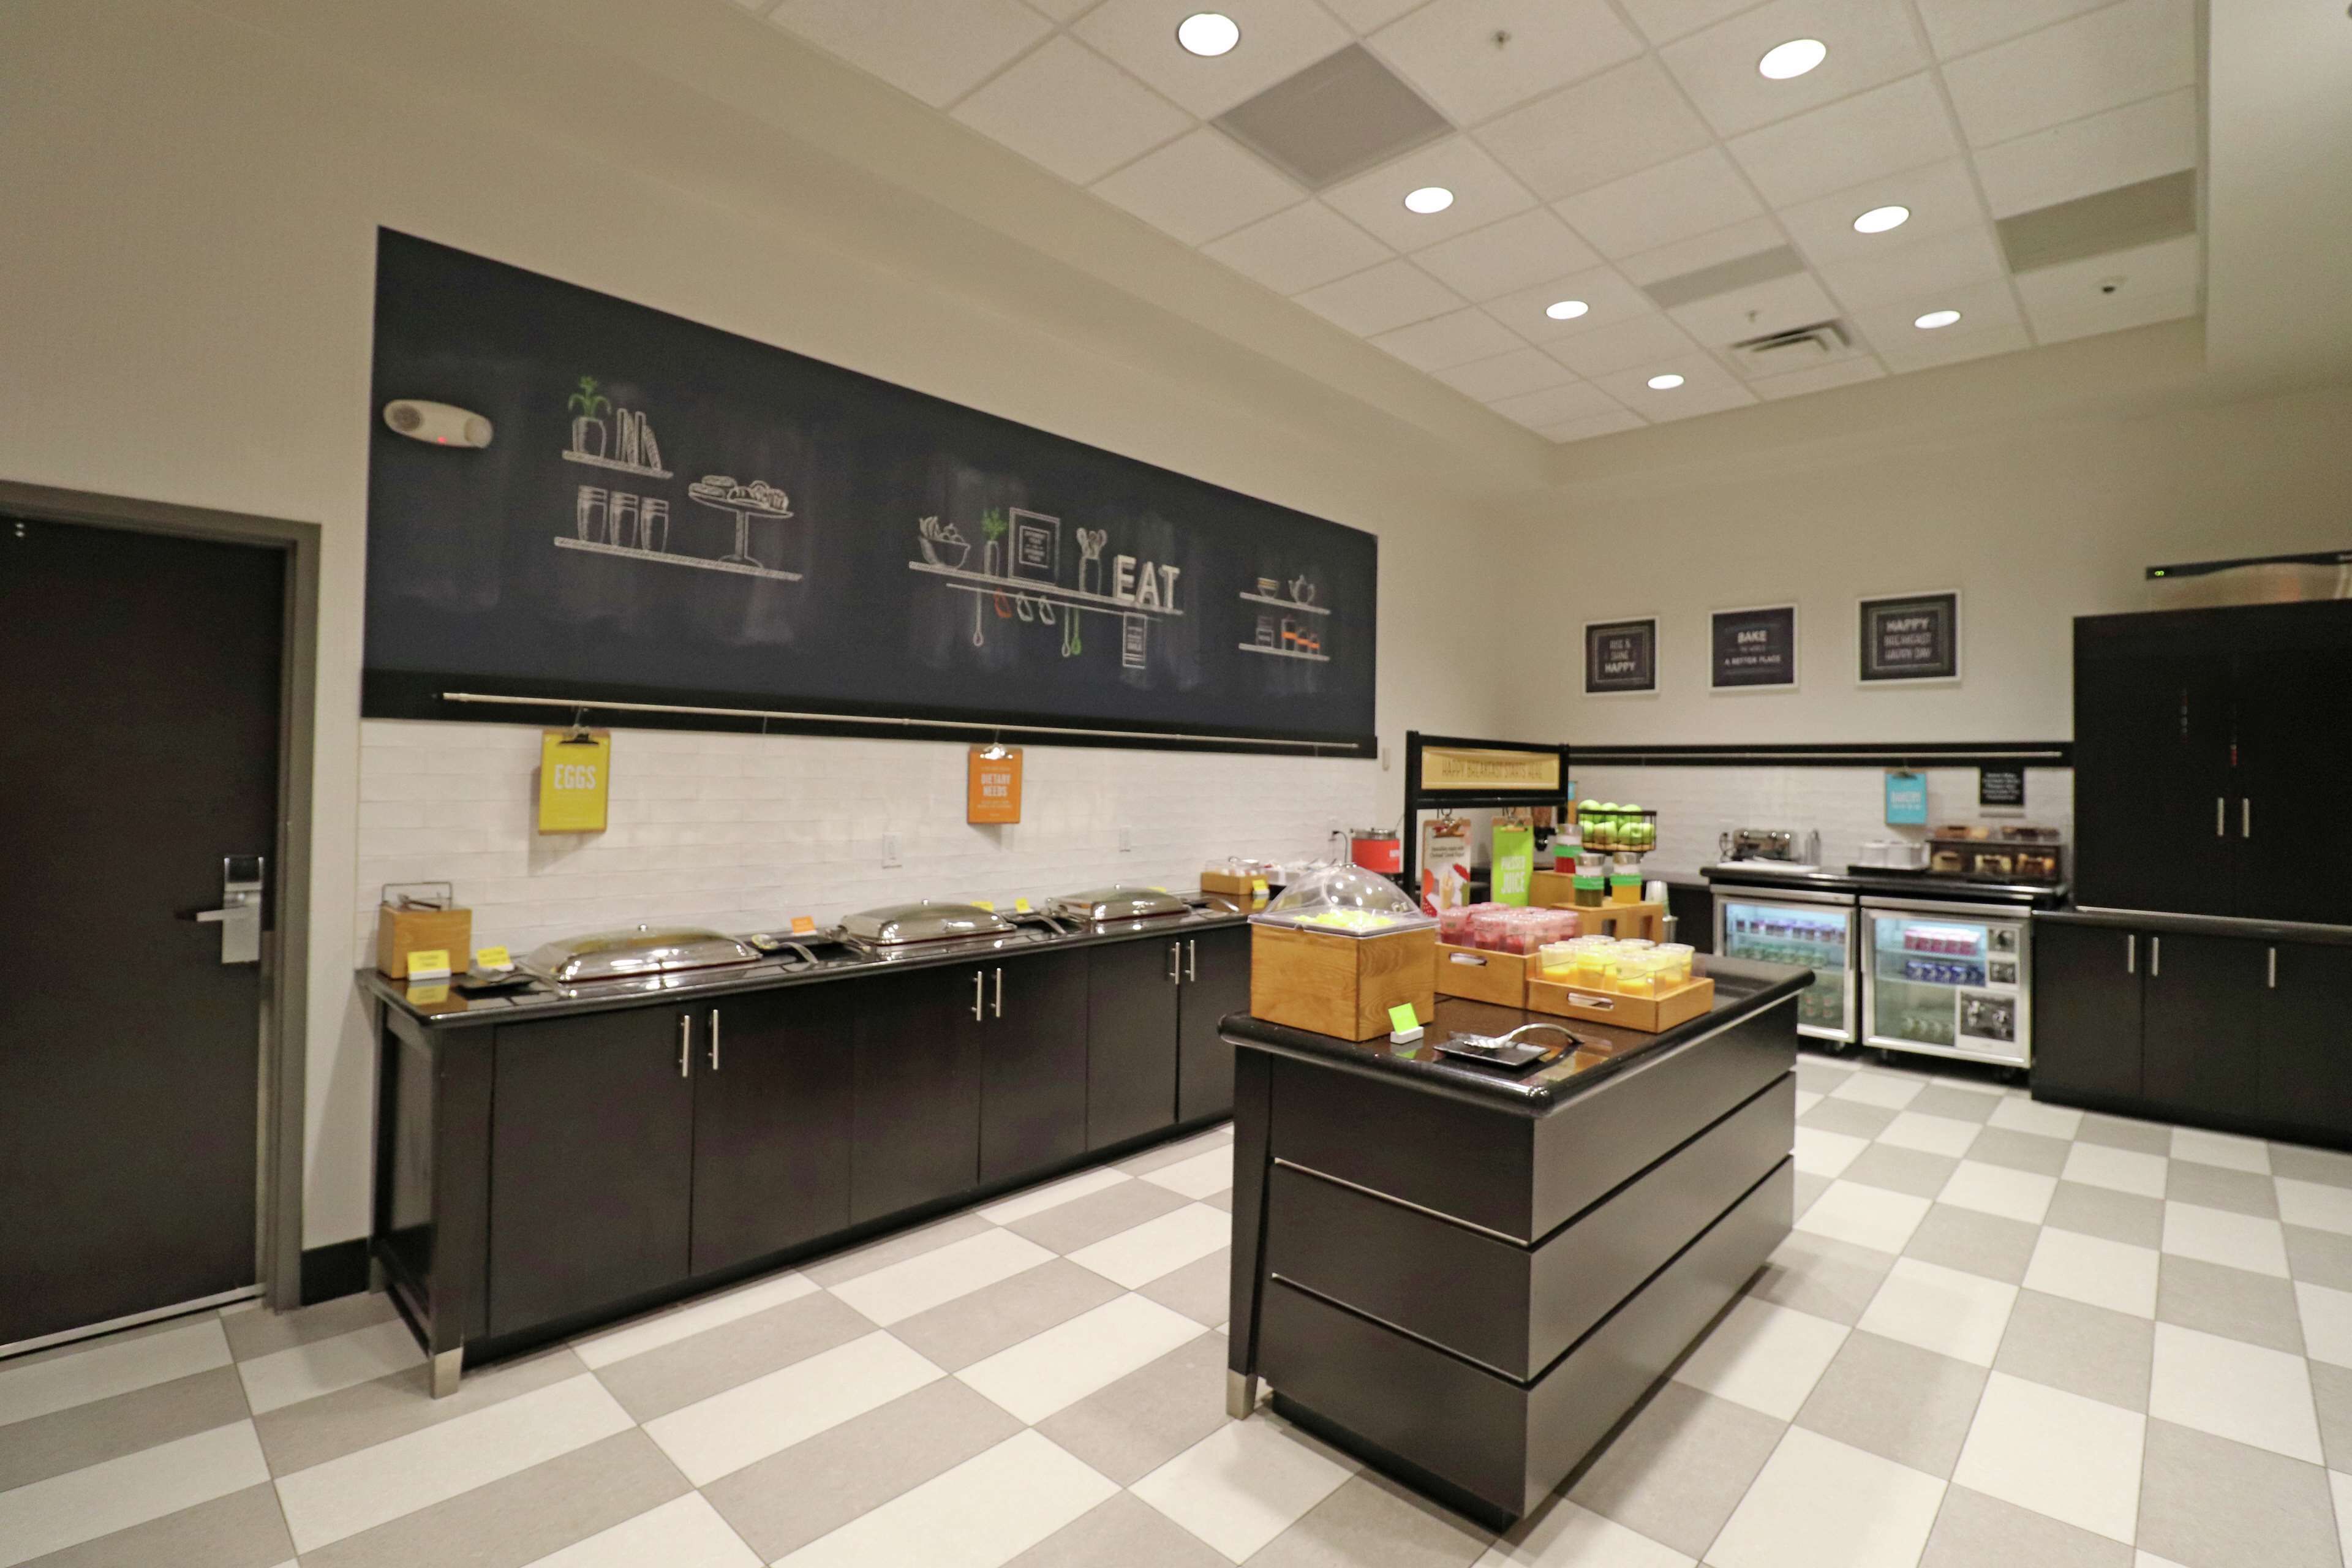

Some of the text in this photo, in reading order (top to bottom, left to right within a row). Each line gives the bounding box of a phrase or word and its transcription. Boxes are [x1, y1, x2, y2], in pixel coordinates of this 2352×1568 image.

[1112, 554, 1180, 610] EAT
[1886, 617, 1930, 631] HAPPY
[1738, 630, 1767, 644] BAKE
[1605, 662, 1636, 673] HAPPY
[554, 764, 597, 790] EGGS
[981, 774, 1012, 785] DIETARY
[982, 785, 1008, 797] NEEDS
[1501, 872, 1525, 894] JUICE
